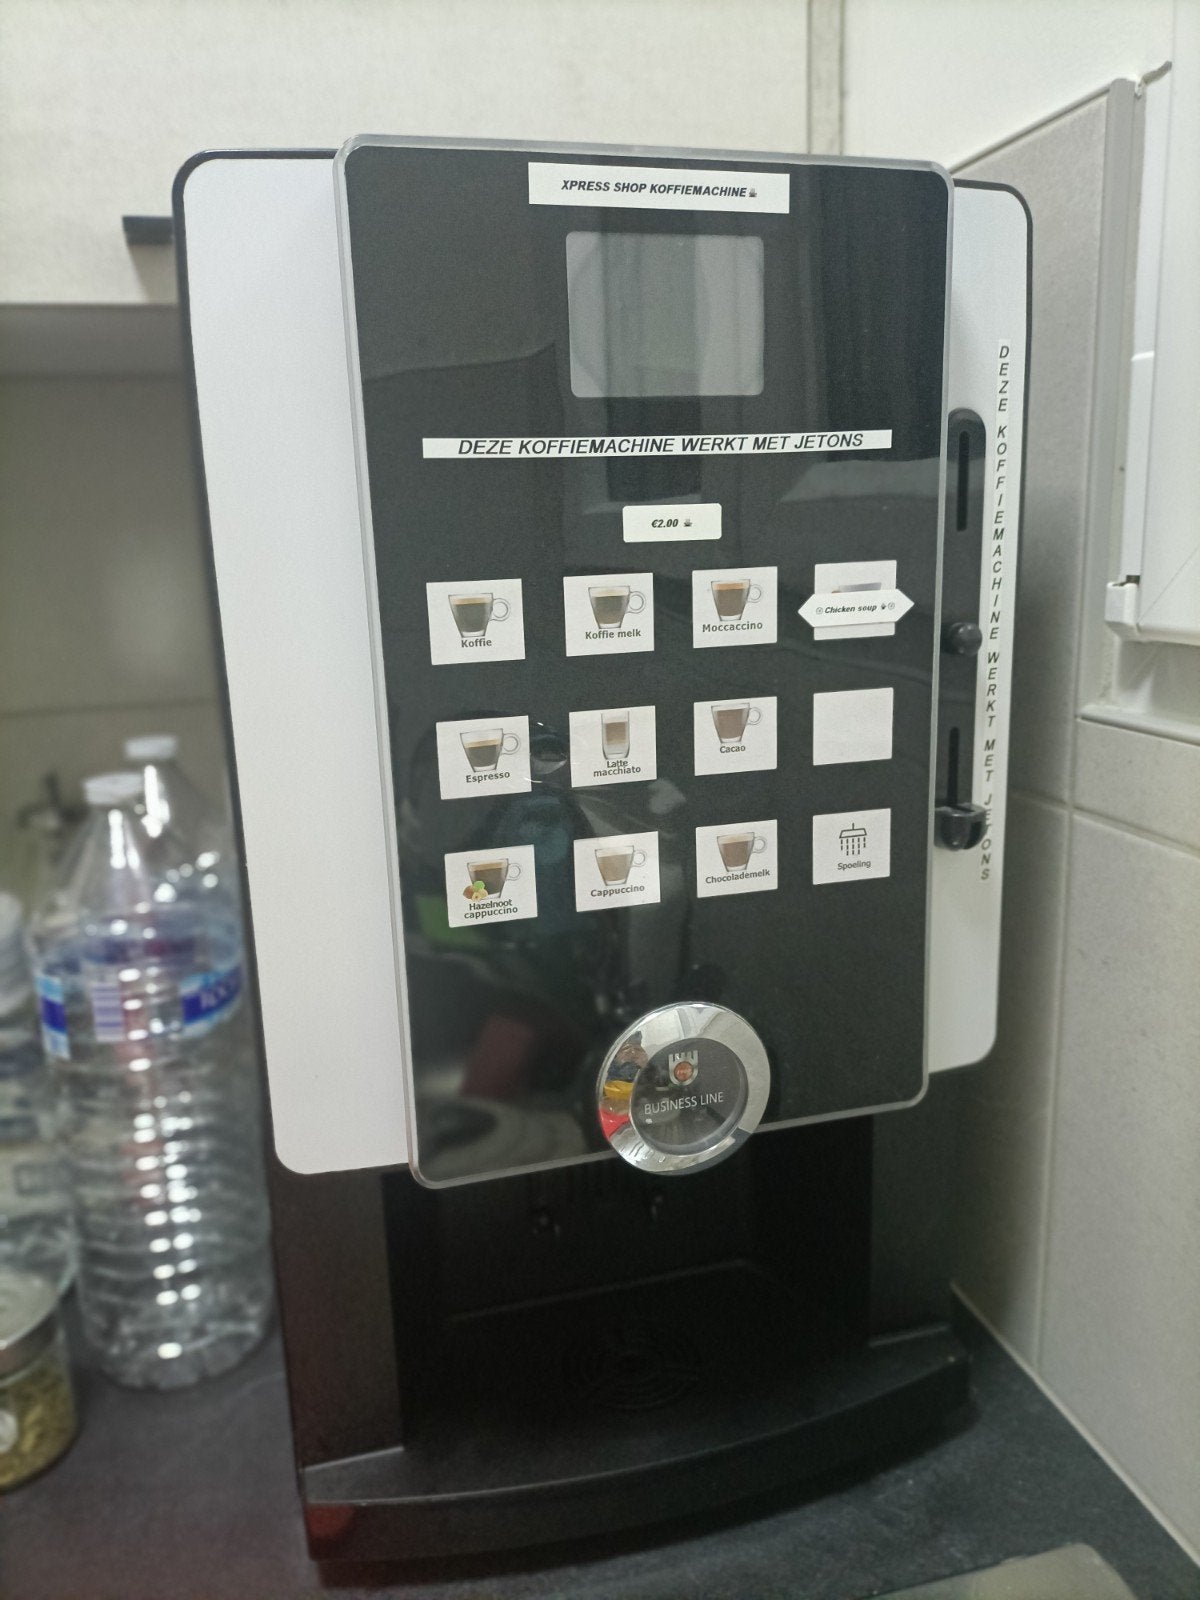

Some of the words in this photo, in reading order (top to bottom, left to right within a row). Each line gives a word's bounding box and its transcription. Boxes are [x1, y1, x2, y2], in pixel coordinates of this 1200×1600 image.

[561, 179, 611, 192] XPRESS
[613, 182, 647, 193] SHOP
[649, 183, 748, 198] KOFFIEMACHINE
[998, 345, 1009, 412] DEZE
[458, 439, 512, 455] DEZE
[518, 437, 674, 455] KOFFIEMACHINE
[681, 436, 746, 452] WERKT
[752, 434, 790, 450] MET
[795, 433, 864, 449] JETONS
[651, 518, 679, 528] €2.00
[989, 425, 1007, 640] KOFFIEMACHINE
[824, 605, 856, 614] Chicken
[858, 604, 877, 613] soup
[702, 621, 763, 633] Moccaccino
[585, 629, 615, 640] Koffie
[617, 628, 642, 638] melk
[461, 638, 493, 648] Koffie
[986, 651, 1000, 728] WERKT
[719, 745, 746, 753] Cacao
[606, 759, 628, 768] Latte
[984, 739, 996, 783] MET
[466, 771, 510, 784] Espresso
[593, 765, 641, 777] macchiato
[837, 860, 871, 871] Spoeling
[705, 869, 771, 884] Chocolademelk
[590, 884, 645, 898] Cappuccino
[468, 899, 513, 911] Hazelnoot
[464, 906, 518, 920] cappuccino
[644, 1096, 697, 1114] BUSINESS
[700, 1092, 724, 1105] LINE
